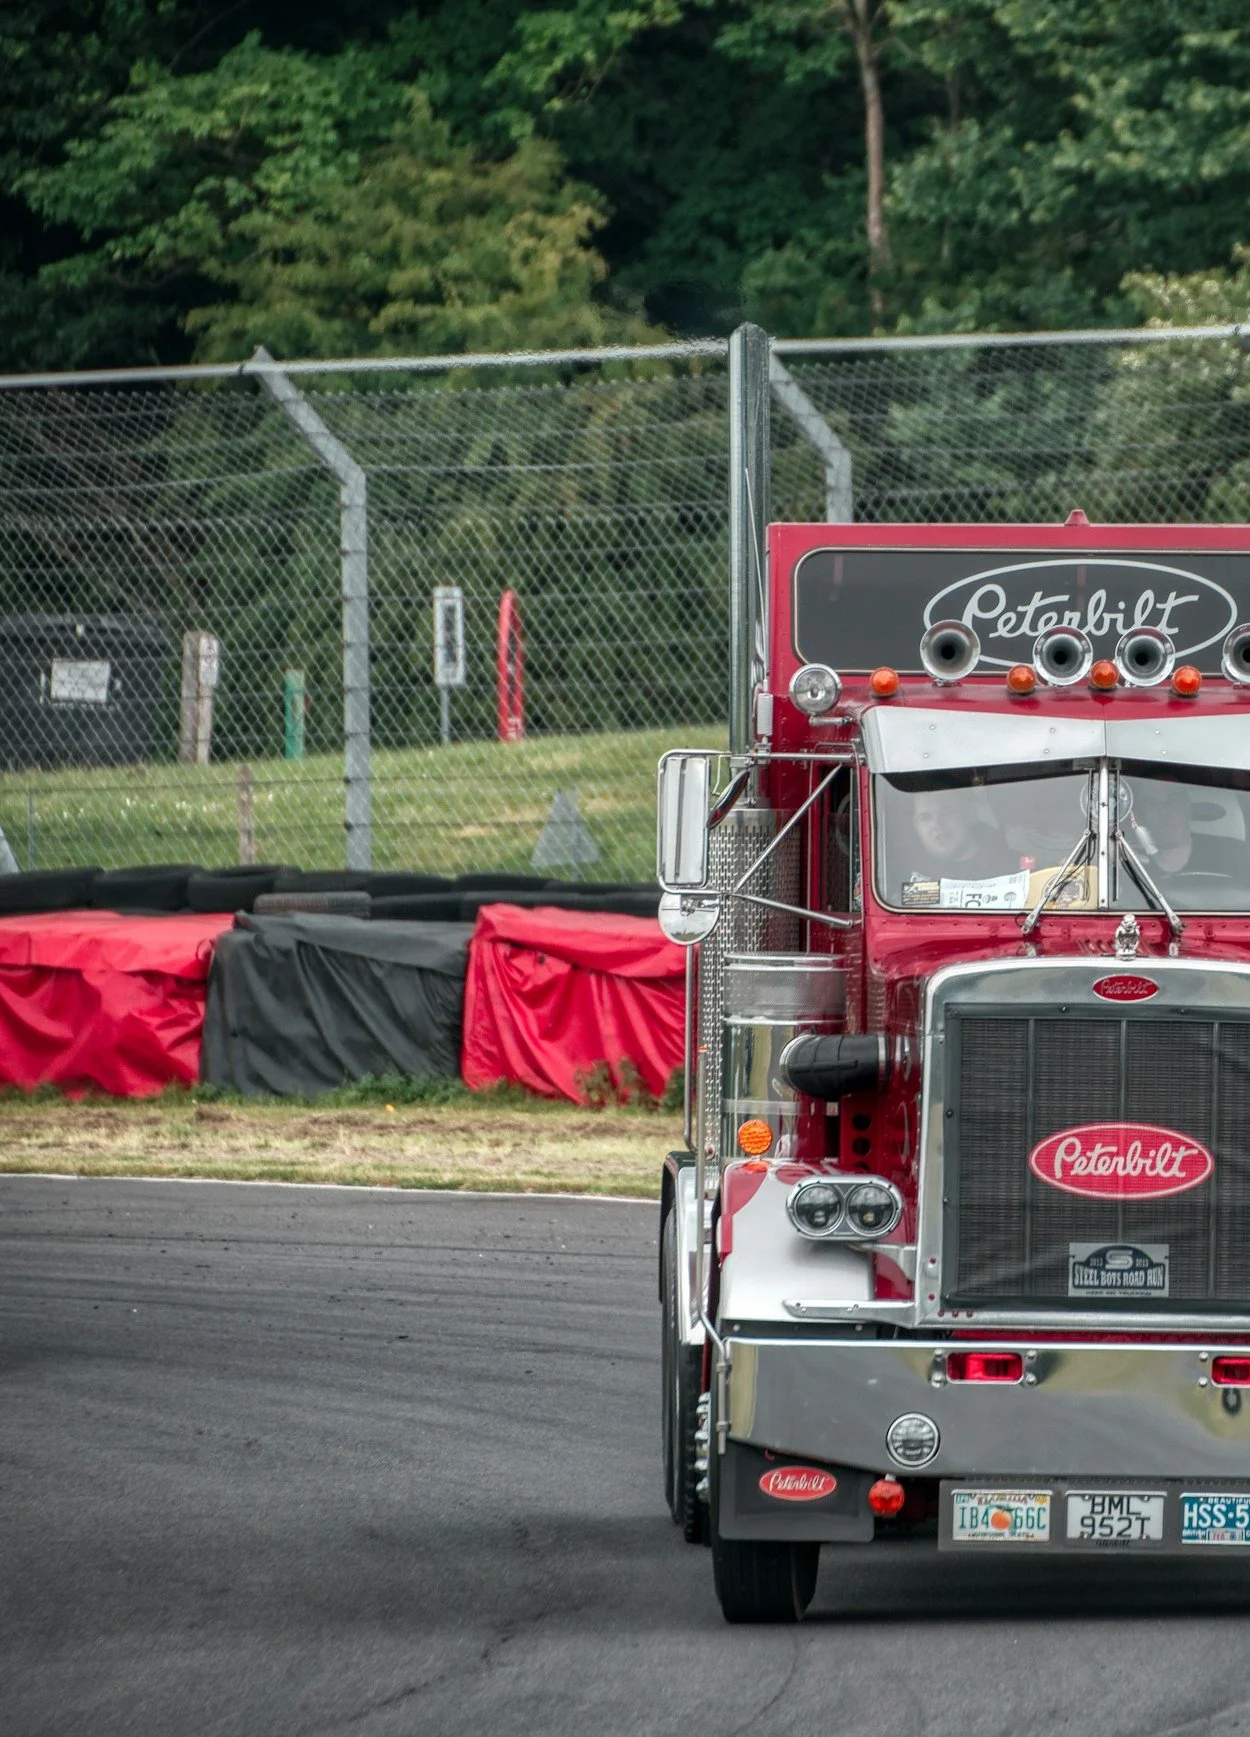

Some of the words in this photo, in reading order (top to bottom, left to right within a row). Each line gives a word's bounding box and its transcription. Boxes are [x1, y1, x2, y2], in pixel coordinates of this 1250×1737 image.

[962, 583, 1200, 638] Peterbilt
[1100, 979, 1154, 995] Peterbilt
[1054, 1136, 1199, 1178] Peterbilt
[1074, 1264, 1100, 1286] STEEL
[1100, 1270, 1121, 1287] BOYS
[1122, 1270, 1145, 1287] ROAD
[1146, 1265, 1164, 1287] RUN
[769, 1471, 829, 1492] Peterbilt
[1090, 1496, 1142, 1516] BML
[1080, 1516, 1151, 1538] 952T
